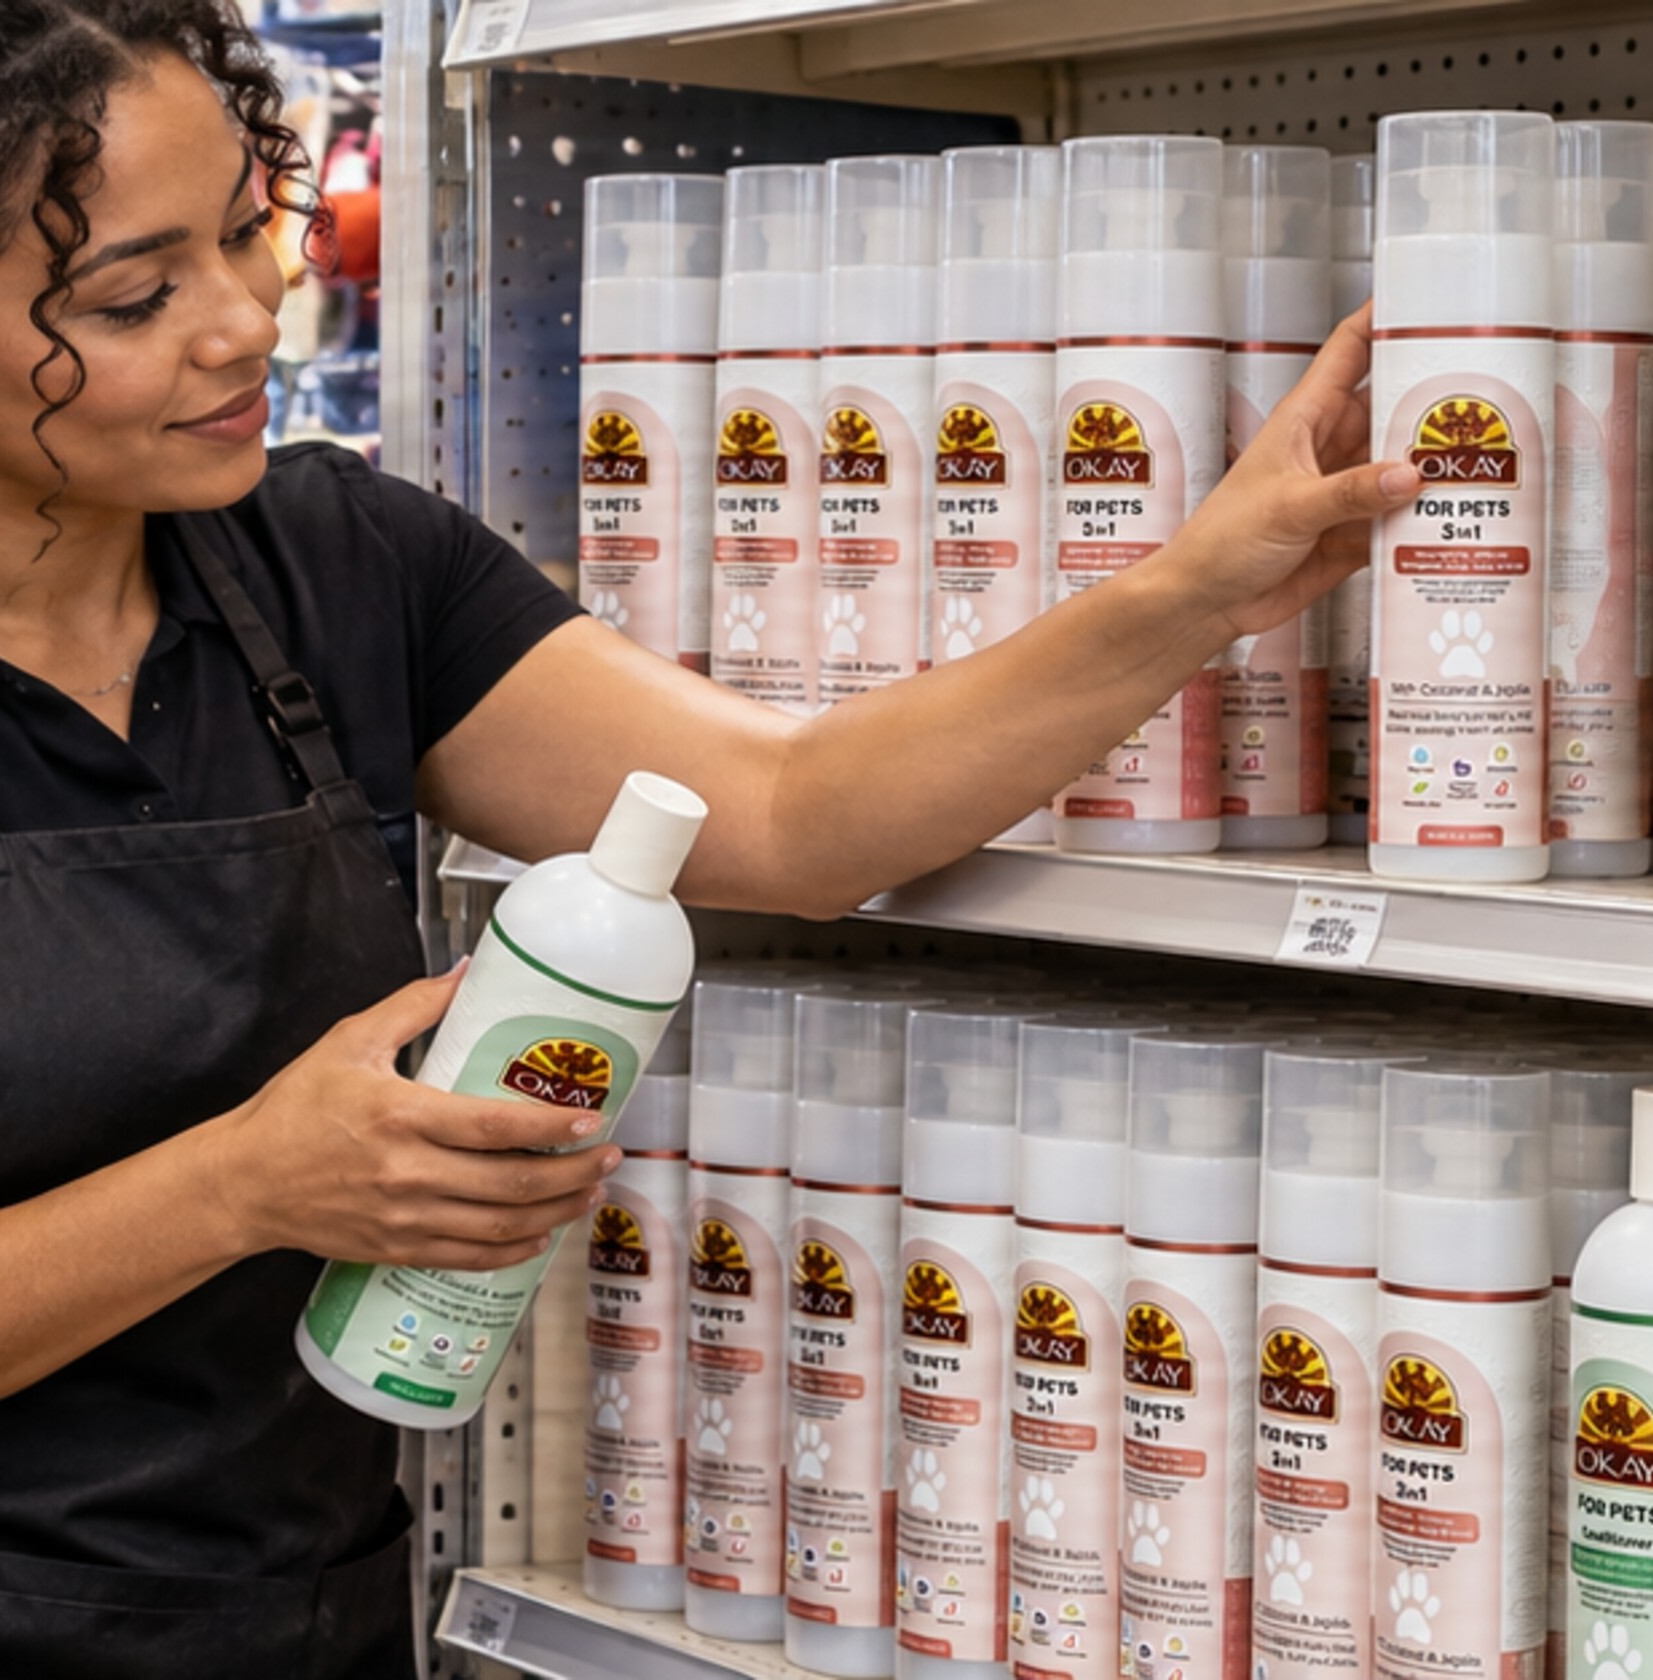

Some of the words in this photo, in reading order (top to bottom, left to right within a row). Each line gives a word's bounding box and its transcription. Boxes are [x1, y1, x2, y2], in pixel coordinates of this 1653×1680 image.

[1067, 457, 1140, 479] OKAY
[1418, 455, 1508, 478] OKAY
[1096, 499, 1143, 515] PETS
[1459, 500, 1510, 517] PETS
[514, 1070, 602, 1108] OKAY
[793, 1292, 846, 1314] KAY
[1261, 1379, 1325, 1413] OKAY
[1383, 1409, 1451, 1443] OKAY
[1284, 1428, 1328, 1451] PETS
[1409, 1458, 1455, 1483] PETS
[1578, 1493, 1607, 1517] FOR
